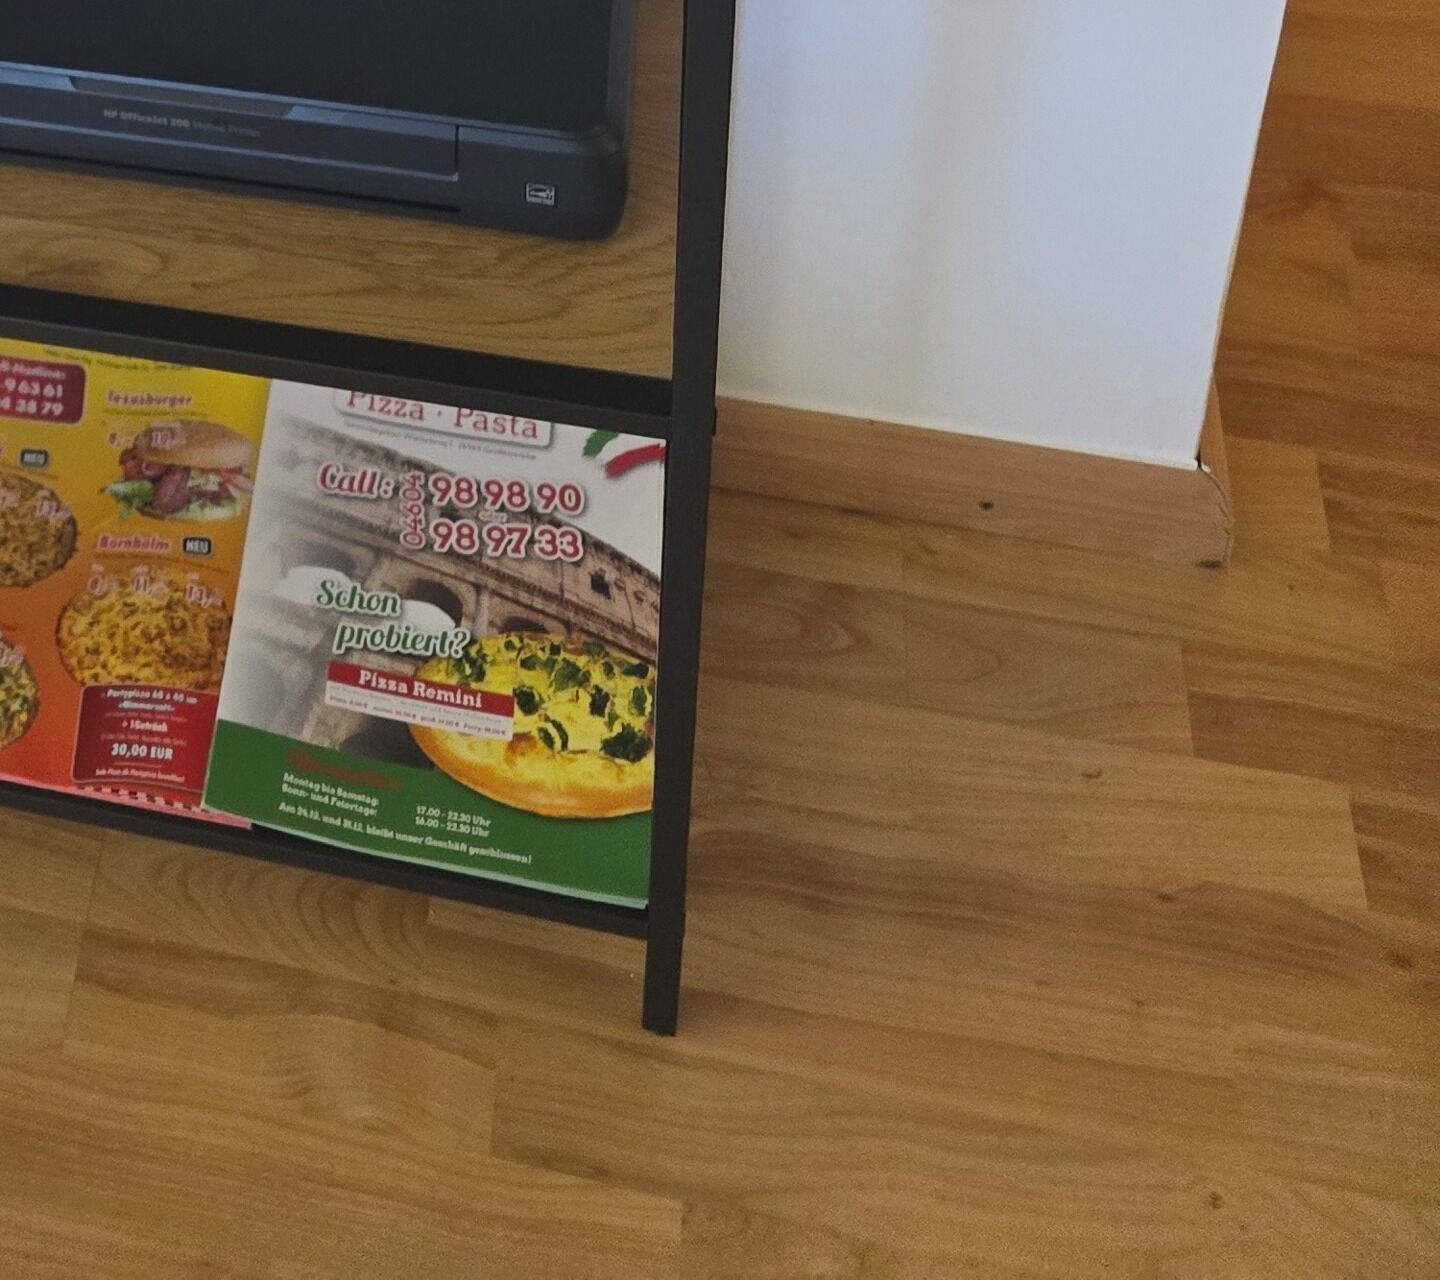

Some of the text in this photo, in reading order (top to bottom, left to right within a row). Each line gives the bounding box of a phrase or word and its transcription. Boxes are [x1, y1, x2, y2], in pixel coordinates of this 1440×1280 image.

[347, 390, 425, 422] Pizza
[453, 406, 538, 440] Pasta
[319, 463, 583, 514] Call: 98 98 90
[401, 473, 425, 548] 04604
[185, 539, 210, 553] NEU
[432, 519, 583, 561] 98 97 33
[317, 579, 400, 615] Schon
[334, 624, 469, 657] probiert?
[359, 670, 483, 708] Pizza Remini
[111, 742, 174, 761] 30,00 EUR
[283, 771, 321, 792] Montag
[311, 792, 330, 804] und
[279, 801, 296, 814] Am
[322, 813, 342, 827] und
[366, 824, 394, 840] bleibt
[395, 831, 424, 845] unser
[425, 836, 468, 853] Geschäft
[468, 843, 532, 865] geschlossen!
[416, 804, 441, 818] 17.00
[473, 813, 492, 828] Uhr
[472, 824, 490, 837] Uhr
